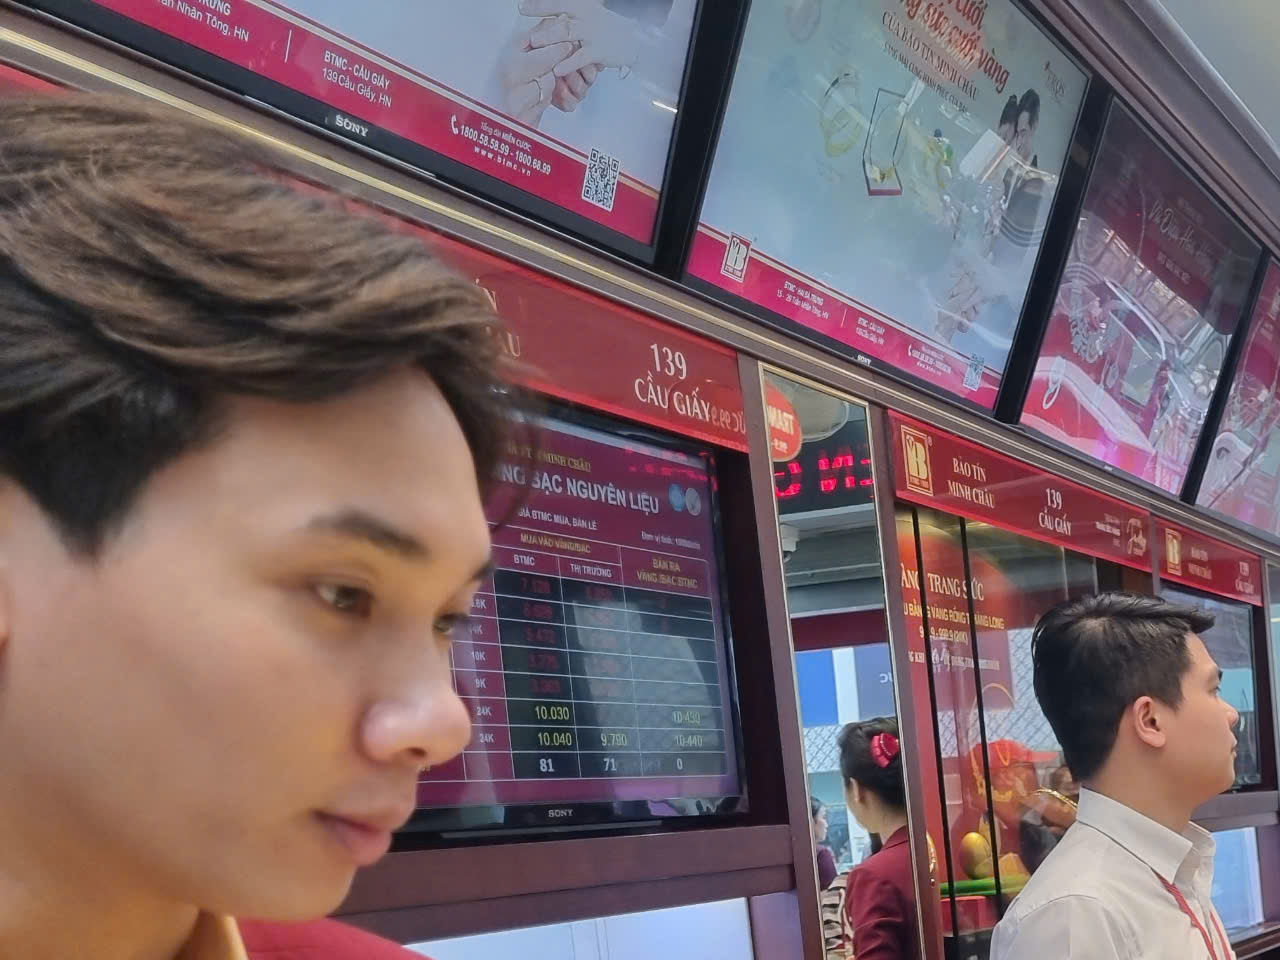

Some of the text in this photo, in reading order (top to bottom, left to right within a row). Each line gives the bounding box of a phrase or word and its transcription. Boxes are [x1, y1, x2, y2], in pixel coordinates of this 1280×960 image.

[177, 0, 203, 21] Nhân
[205, 12, 231, 36] Tông,
[234, 26, 249, 42] HN
[324, 50, 347, 71] BTMC
[936, 54, 957, 83] MINH
[978, 47, 1010, 94] vàng
[322, 68, 338, 84] 139
[379, 93, 392, 108] HN
[335, 114, 369, 137] SONY
[460, 124, 510, 156] 1800.58.58.99
[650, 343, 687, 380] 139
[634, 370, 711, 421] CẦU GIẤY
[566, 477, 626, 508] NGUYÊN
[629, 491, 659, 516] LIỆU
[947, 480, 971, 501] MINH
[972, 486, 996, 509] CHÂU
[1045, 488, 1062, 510] 139
[531, 509, 553, 522] BTMC
[520, 532, 538, 546] MUA
[513, 554, 535, 566] BTMC
[901, 562, 920, 590] ÀNG
[927, 572, 960, 598] TRANG
[476, 706, 492, 717] 24K
[535, 705, 570, 722] 10.030
[479, 733, 494, 744] 24K
[537, 732, 572, 747] 10.040
[539, 758, 683, 772] 81 71 0
[548, 808, 573, 818] SONY
